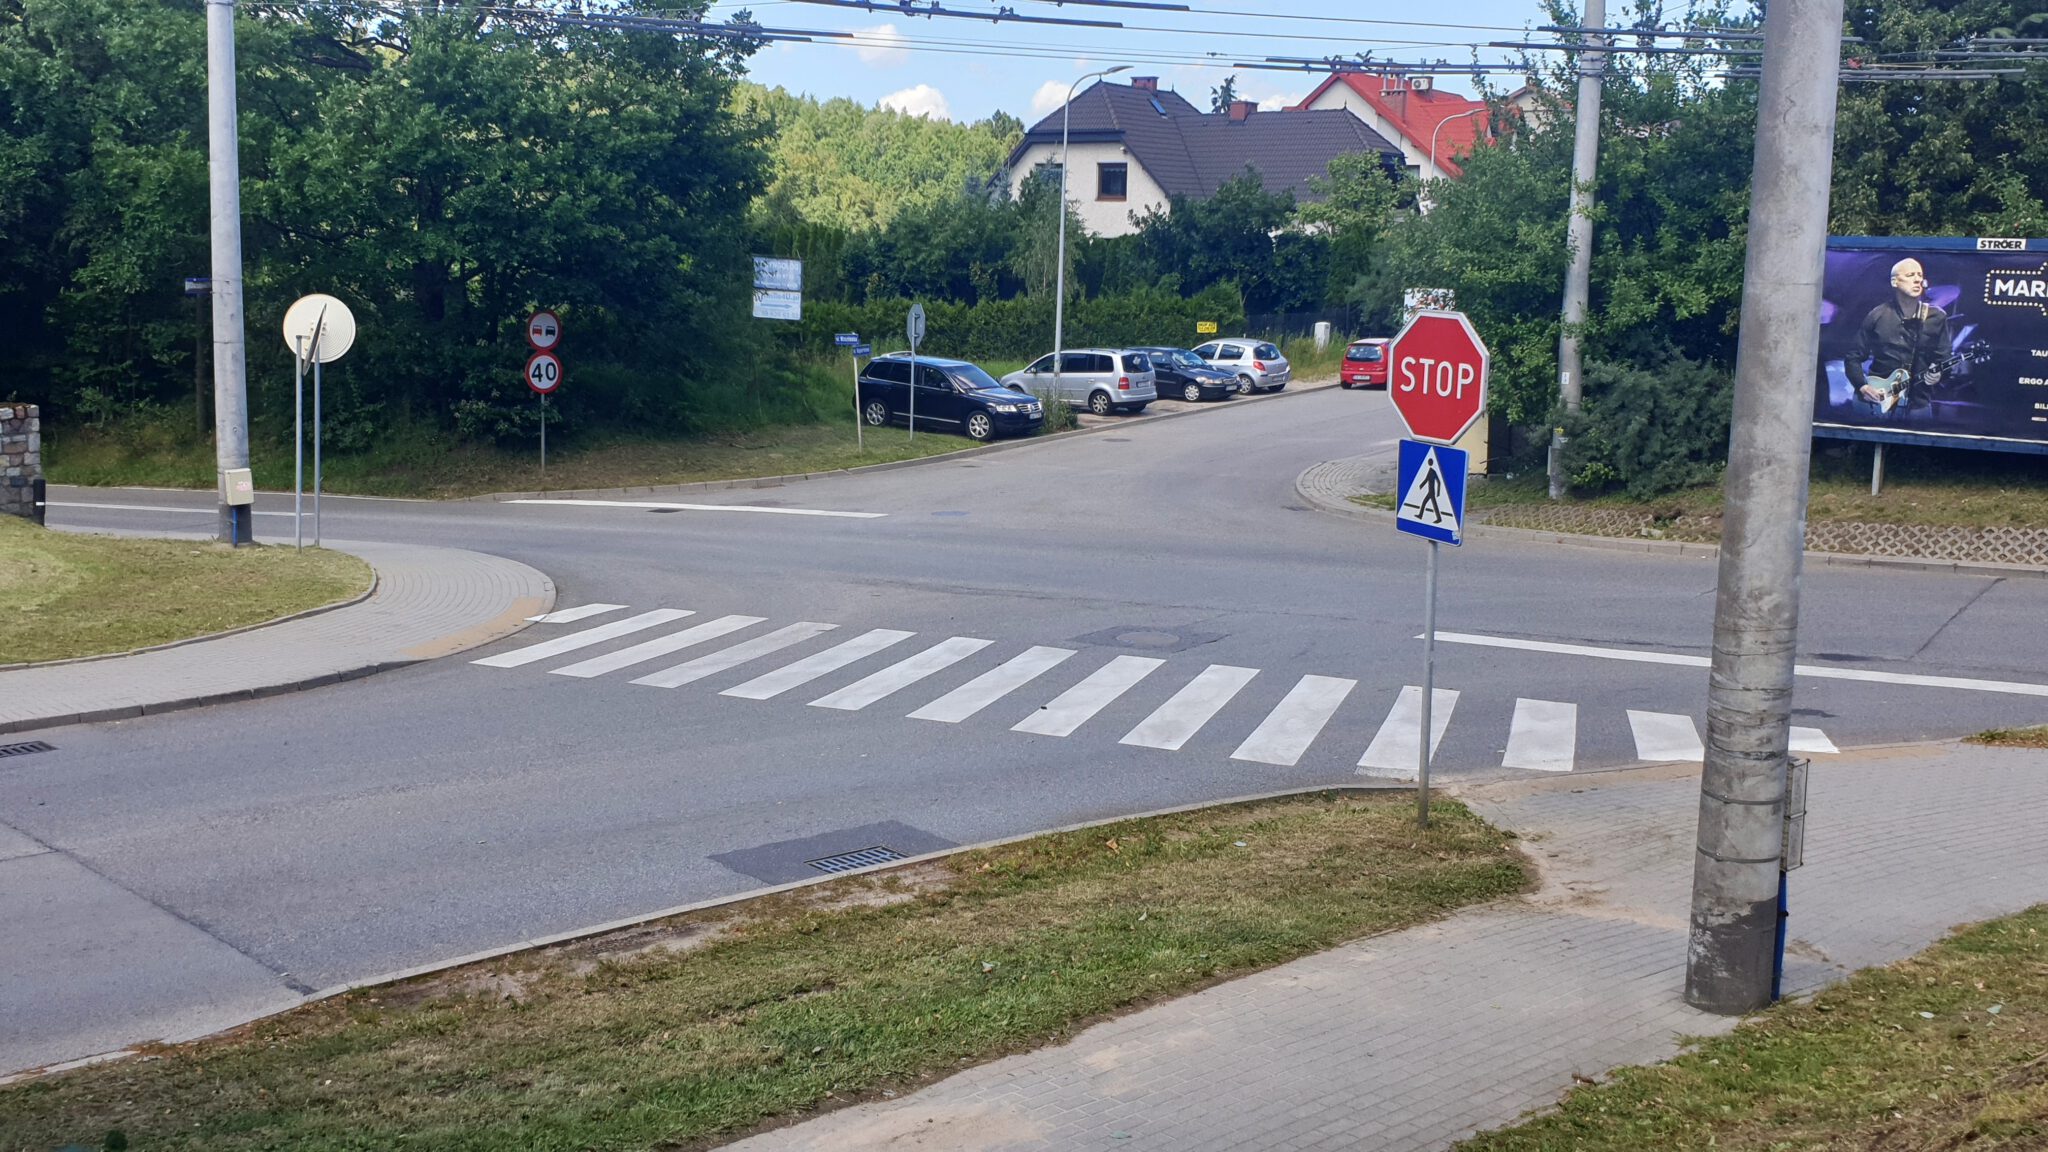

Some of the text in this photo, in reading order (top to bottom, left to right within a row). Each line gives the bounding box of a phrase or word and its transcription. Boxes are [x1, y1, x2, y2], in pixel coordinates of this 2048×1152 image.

[1980, 239, 2023, 249] STRÖER
[1994, 279, 2048, 297] MAR
[531, 362, 557, 382] 40
[1400, 356, 1474, 399] STOP
[2018, 377, 2043, 385] ERGO
